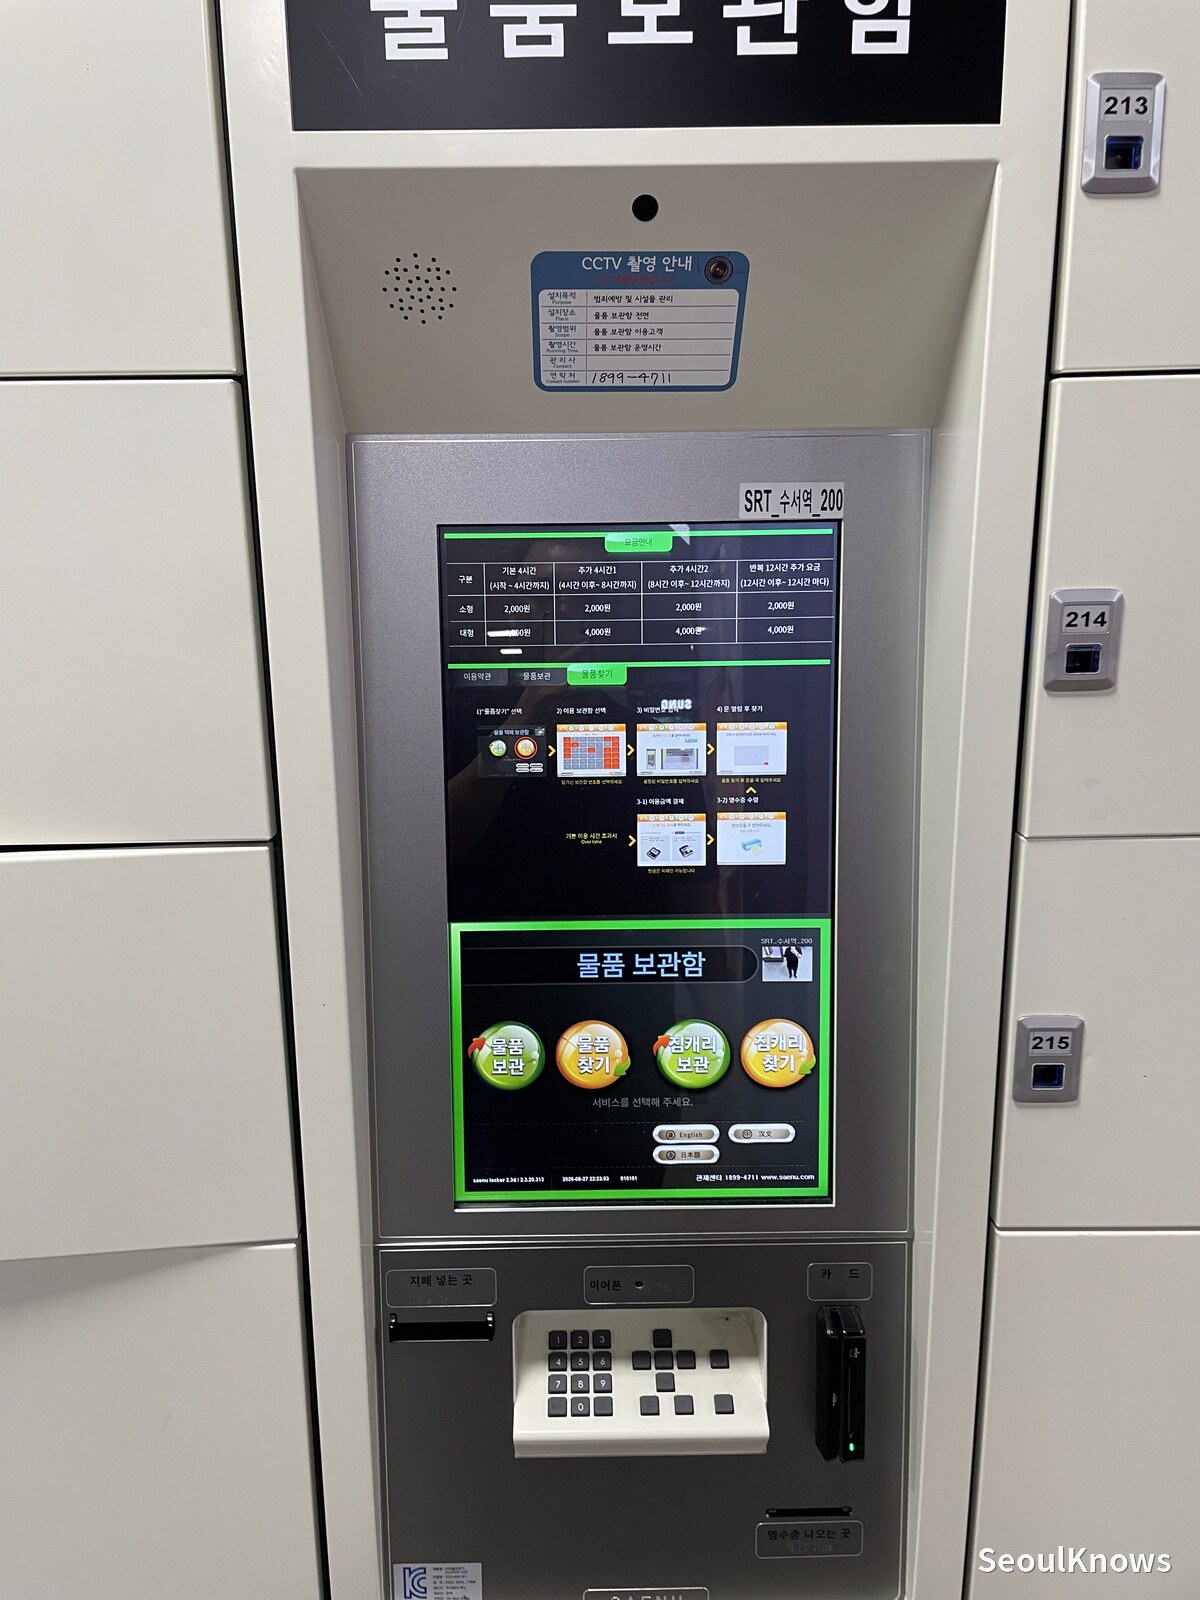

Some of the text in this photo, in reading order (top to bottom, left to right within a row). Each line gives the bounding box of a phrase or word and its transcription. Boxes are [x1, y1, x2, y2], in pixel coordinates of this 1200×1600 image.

[1104, 96, 1148, 115] 213
[582, 256, 692, 272] CCTV 촬영 안내
[548, 292, 576, 300] 설치목적
[594, 294, 673, 304] 범죄예방 및 시설물 관리
[548, 308, 576, 317] 설치장소
[594, 311, 649, 320] 물품 보관함 전면
[548, 324, 577, 333] 촬영범위
[594, 328, 664, 337] 물품 보관함 이용고객
[548, 340, 576, 349] 촬영시간
[594, 344, 662, 352] 물품 보관함 운영시간
[592, 372, 672, 386] 1899-4711
[744, 488, 843, 518] SRT_수서역_200
[624, 537, 653, 548] 요금안내
[502, 566, 537, 576] 기본 4시간
[578, 566, 617, 575] 추가 4시간1
[670, 564, 709, 574] 추가 4시간2
[750, 563, 821, 573] 반복 12시간 추가 요금
[458, 575, 474, 584] 구분
[740, 579, 766, 588] (12시간
[788, 578, 811, 587] 12시간
[812, 578, 830, 587] 마다)
[490, 581, 507, 591] (시작
[514, 580, 550, 591] 4시간까지)
[558, 581, 580, 591] (4시간
[601, 580, 637, 590] 8시간까지)
[648, 580, 670, 590] (8시간
[691, 580, 731, 589] 12시간까지)
[459, 605, 474, 614] 소형
[504, 604, 531, 613] 2,000원
[585, 604, 611, 613] 2,000원
[676, 603, 702, 612] 2,000원
[768, 602, 795, 610] 2,000원
[1065, 611, 1108, 628] 214
[460, 629, 474, 638] 대형
[585, 628, 611, 637] 4,000원
[676, 626, 702, 636] 4,000원
[768, 626, 794, 634] 4,000원
[464, 672, 492, 681] 이용약관
[523, 672, 552, 681] 물품보관
[582, 669, 613, 679] 물품찾기
[636, 798, 648, 806] 3-1)
[577, 951, 706, 978] 물품 보관함
[491, 1038, 525, 1056] 물품
[577, 1036, 610, 1054] 물품
[668, 1035, 718, 1054] 짐캐리
[754, 1034, 804, 1052] 짐캐리
[1032, 1036, 1070, 1050] 215
[491, 1058, 525, 1076] 보관
[577, 1056, 611, 1075] 찾기
[676, 1056, 710, 1074] 보관
[763, 1054, 796, 1072] 찾기
[592, 1096, 694, 1108] 서비스를 선택해 주세요.
[696, 1174, 723, 1182] 관제센터
[410, 1274, 473, 1287] 지폐 넣는 곳
[590, 1280, 622, 1291] 이어폰
[578, 1336, 584, 1344] 2
[578, 1358, 584, 1366] 5
[600, 1357, 606, 1366] 6
[556, 1380, 561, 1389] 7
[578, 1380, 584, 1389] 8
[600, 1380, 606, 1388] 9
[578, 1403, 584, 1411] 0
[768, 1528, 851, 1541] 영수증 나오는 곳
